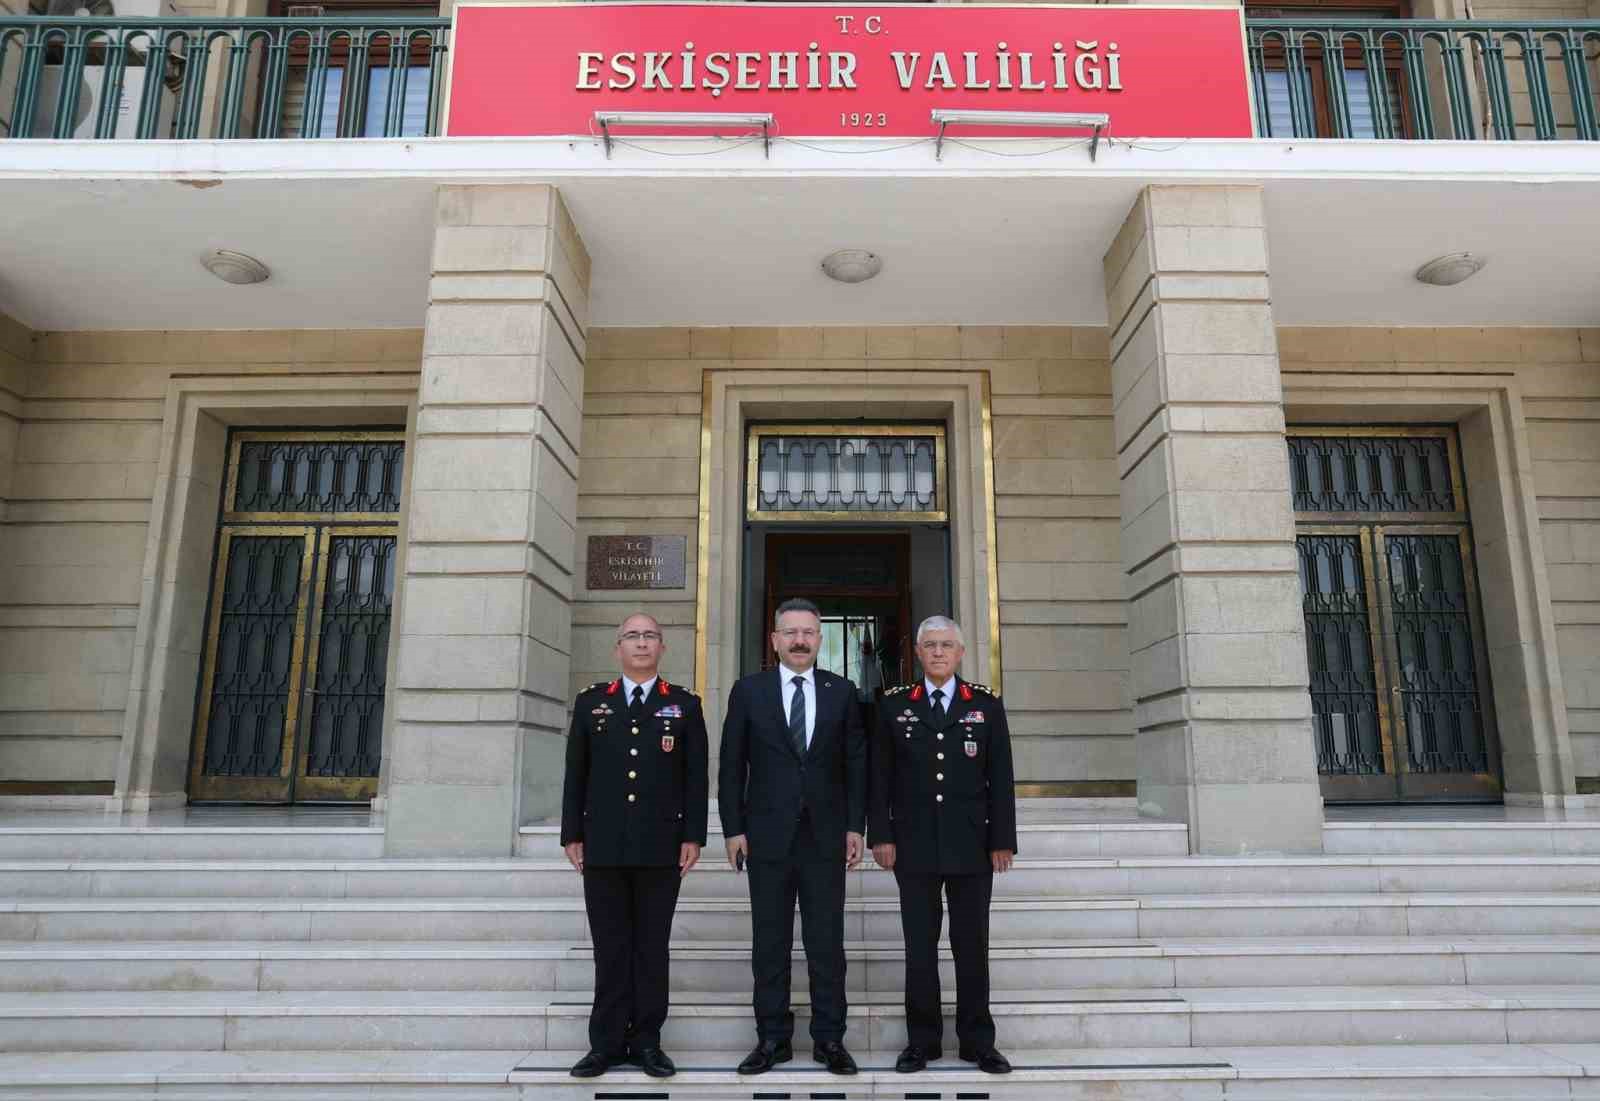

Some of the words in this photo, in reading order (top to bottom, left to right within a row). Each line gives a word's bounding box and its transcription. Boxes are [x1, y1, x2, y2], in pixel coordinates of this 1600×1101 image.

[575, 41, 857, 97] ESKİŞEHİR
[890, 40, 1123, 91] VALİLİĞİ
[840, 112, 887, 127] 1923
